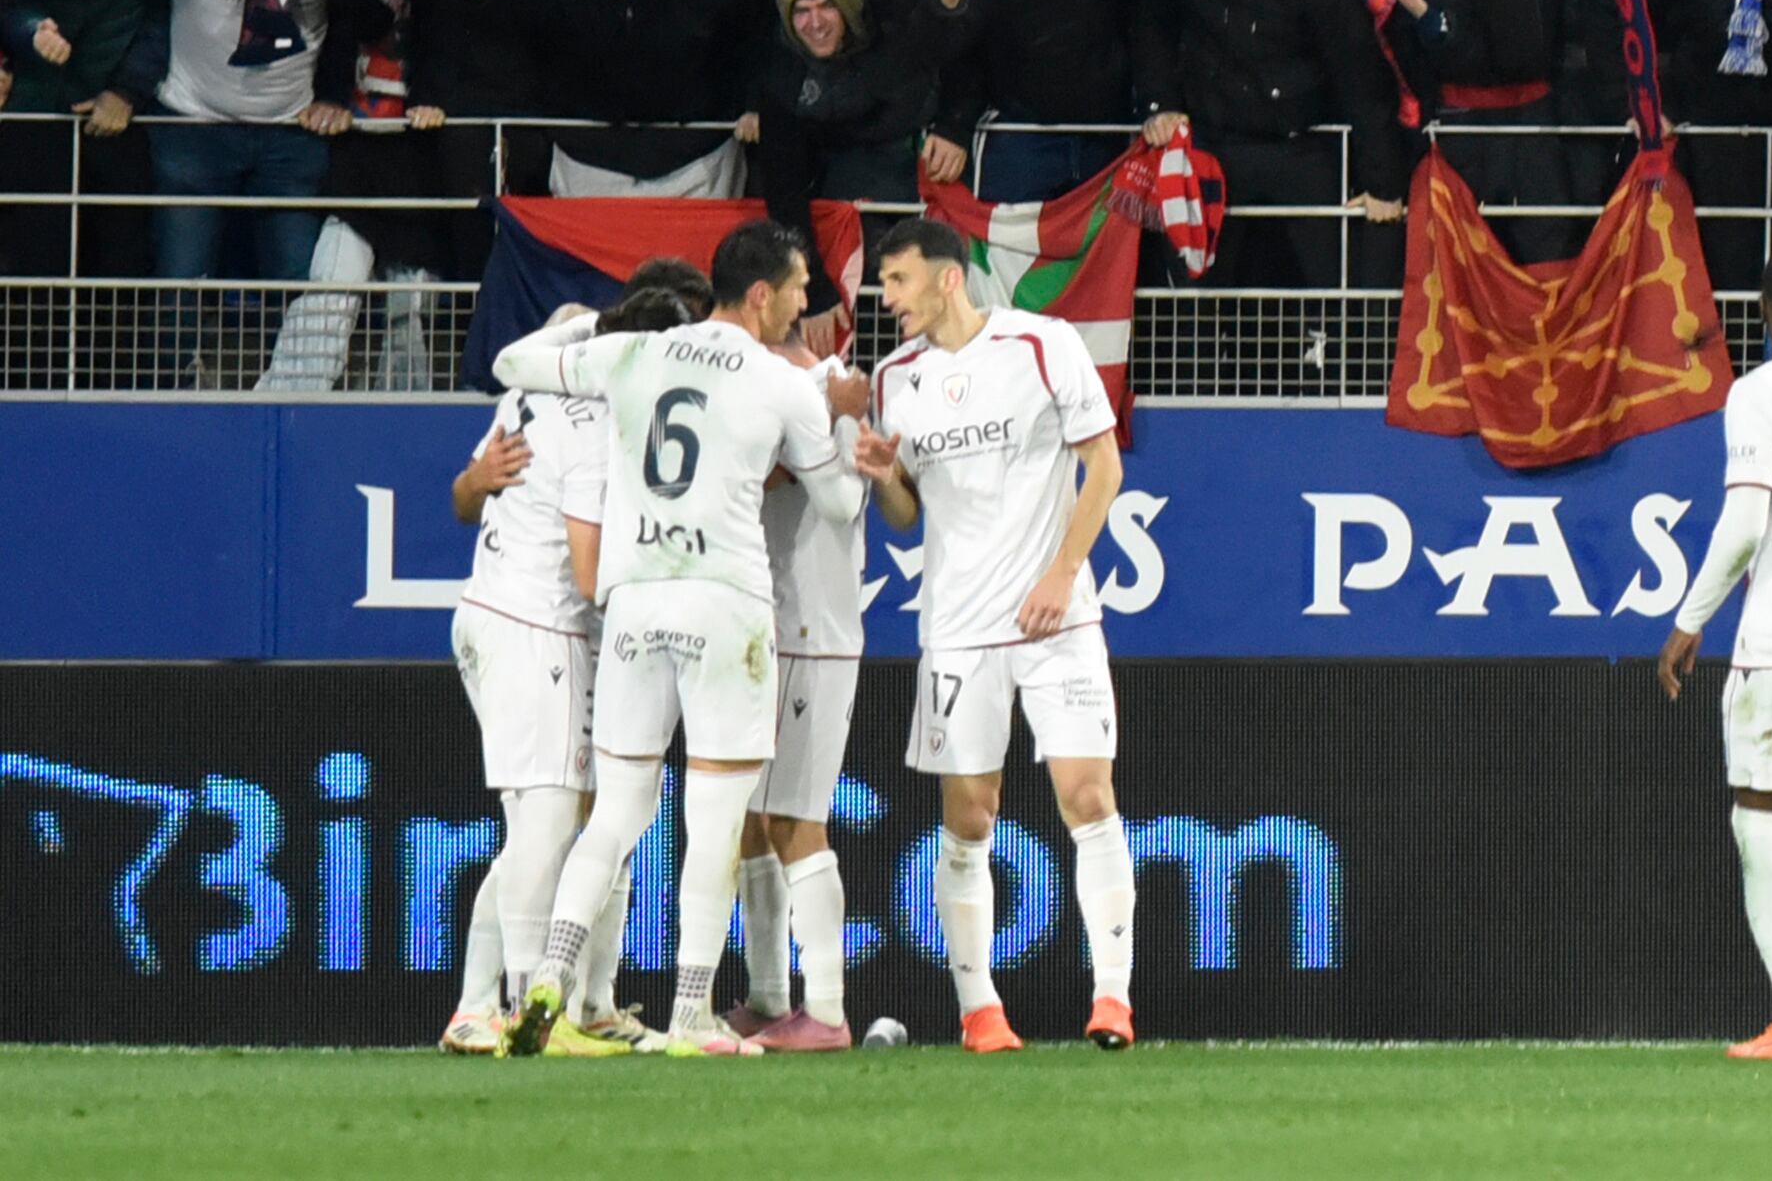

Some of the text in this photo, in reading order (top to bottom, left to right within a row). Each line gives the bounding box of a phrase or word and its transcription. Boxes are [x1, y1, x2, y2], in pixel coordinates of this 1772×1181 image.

[643, 386, 708, 501] 6
[642, 629, 707, 651] CRYPTO
[930, 670, 963, 718] 17
